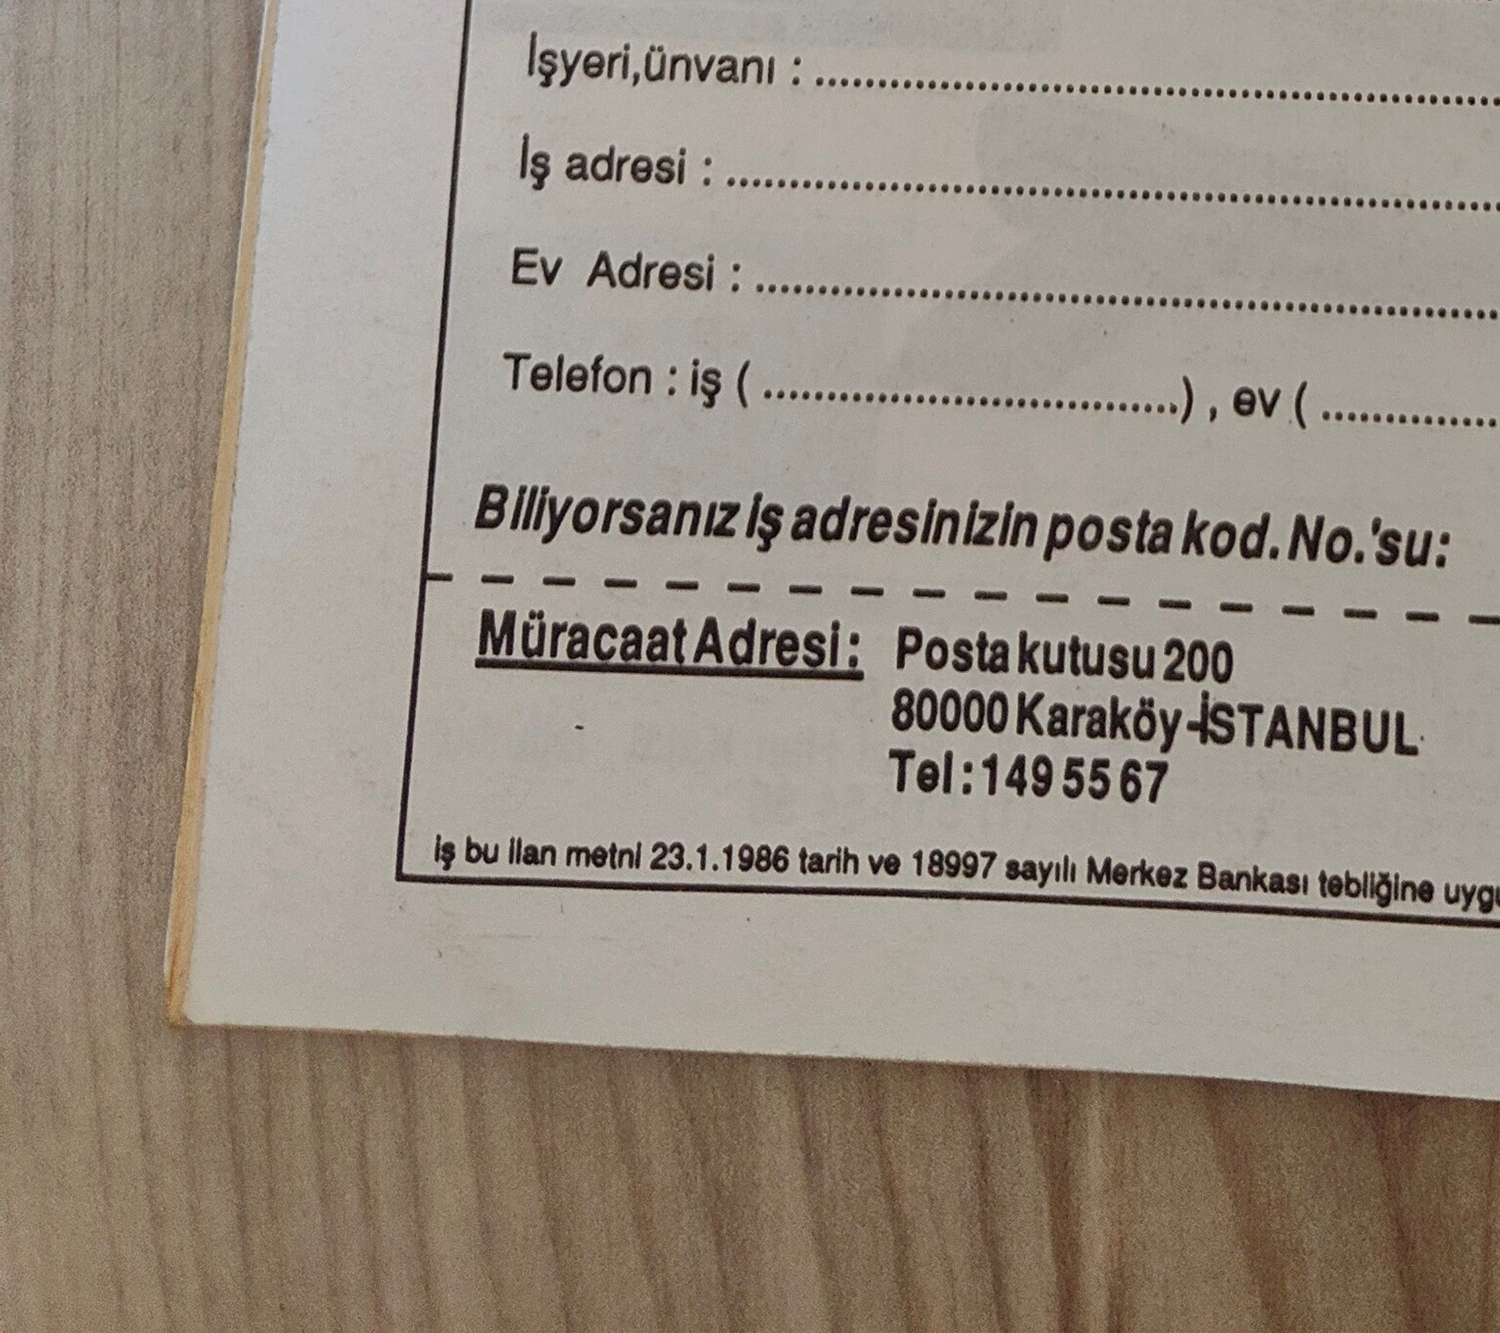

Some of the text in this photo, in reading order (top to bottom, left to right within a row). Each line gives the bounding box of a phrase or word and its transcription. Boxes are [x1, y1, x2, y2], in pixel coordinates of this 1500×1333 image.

[519, 133, 686, 191] İş adresi
[511, 247, 715, 292] Ev Adresi
[464, 835, 500, 865] bu
[649, 841, 790, 874] 23.1.1986
[798, 846, 860, 875] tarih
[867, 853, 902, 876] ve
[912, 848, 998, 880] 18997
[1005, 854, 1077, 889] sayılı
[1086, 855, 1188, 890] Merkez
[1197, 861, 1309, 896] Bankası
